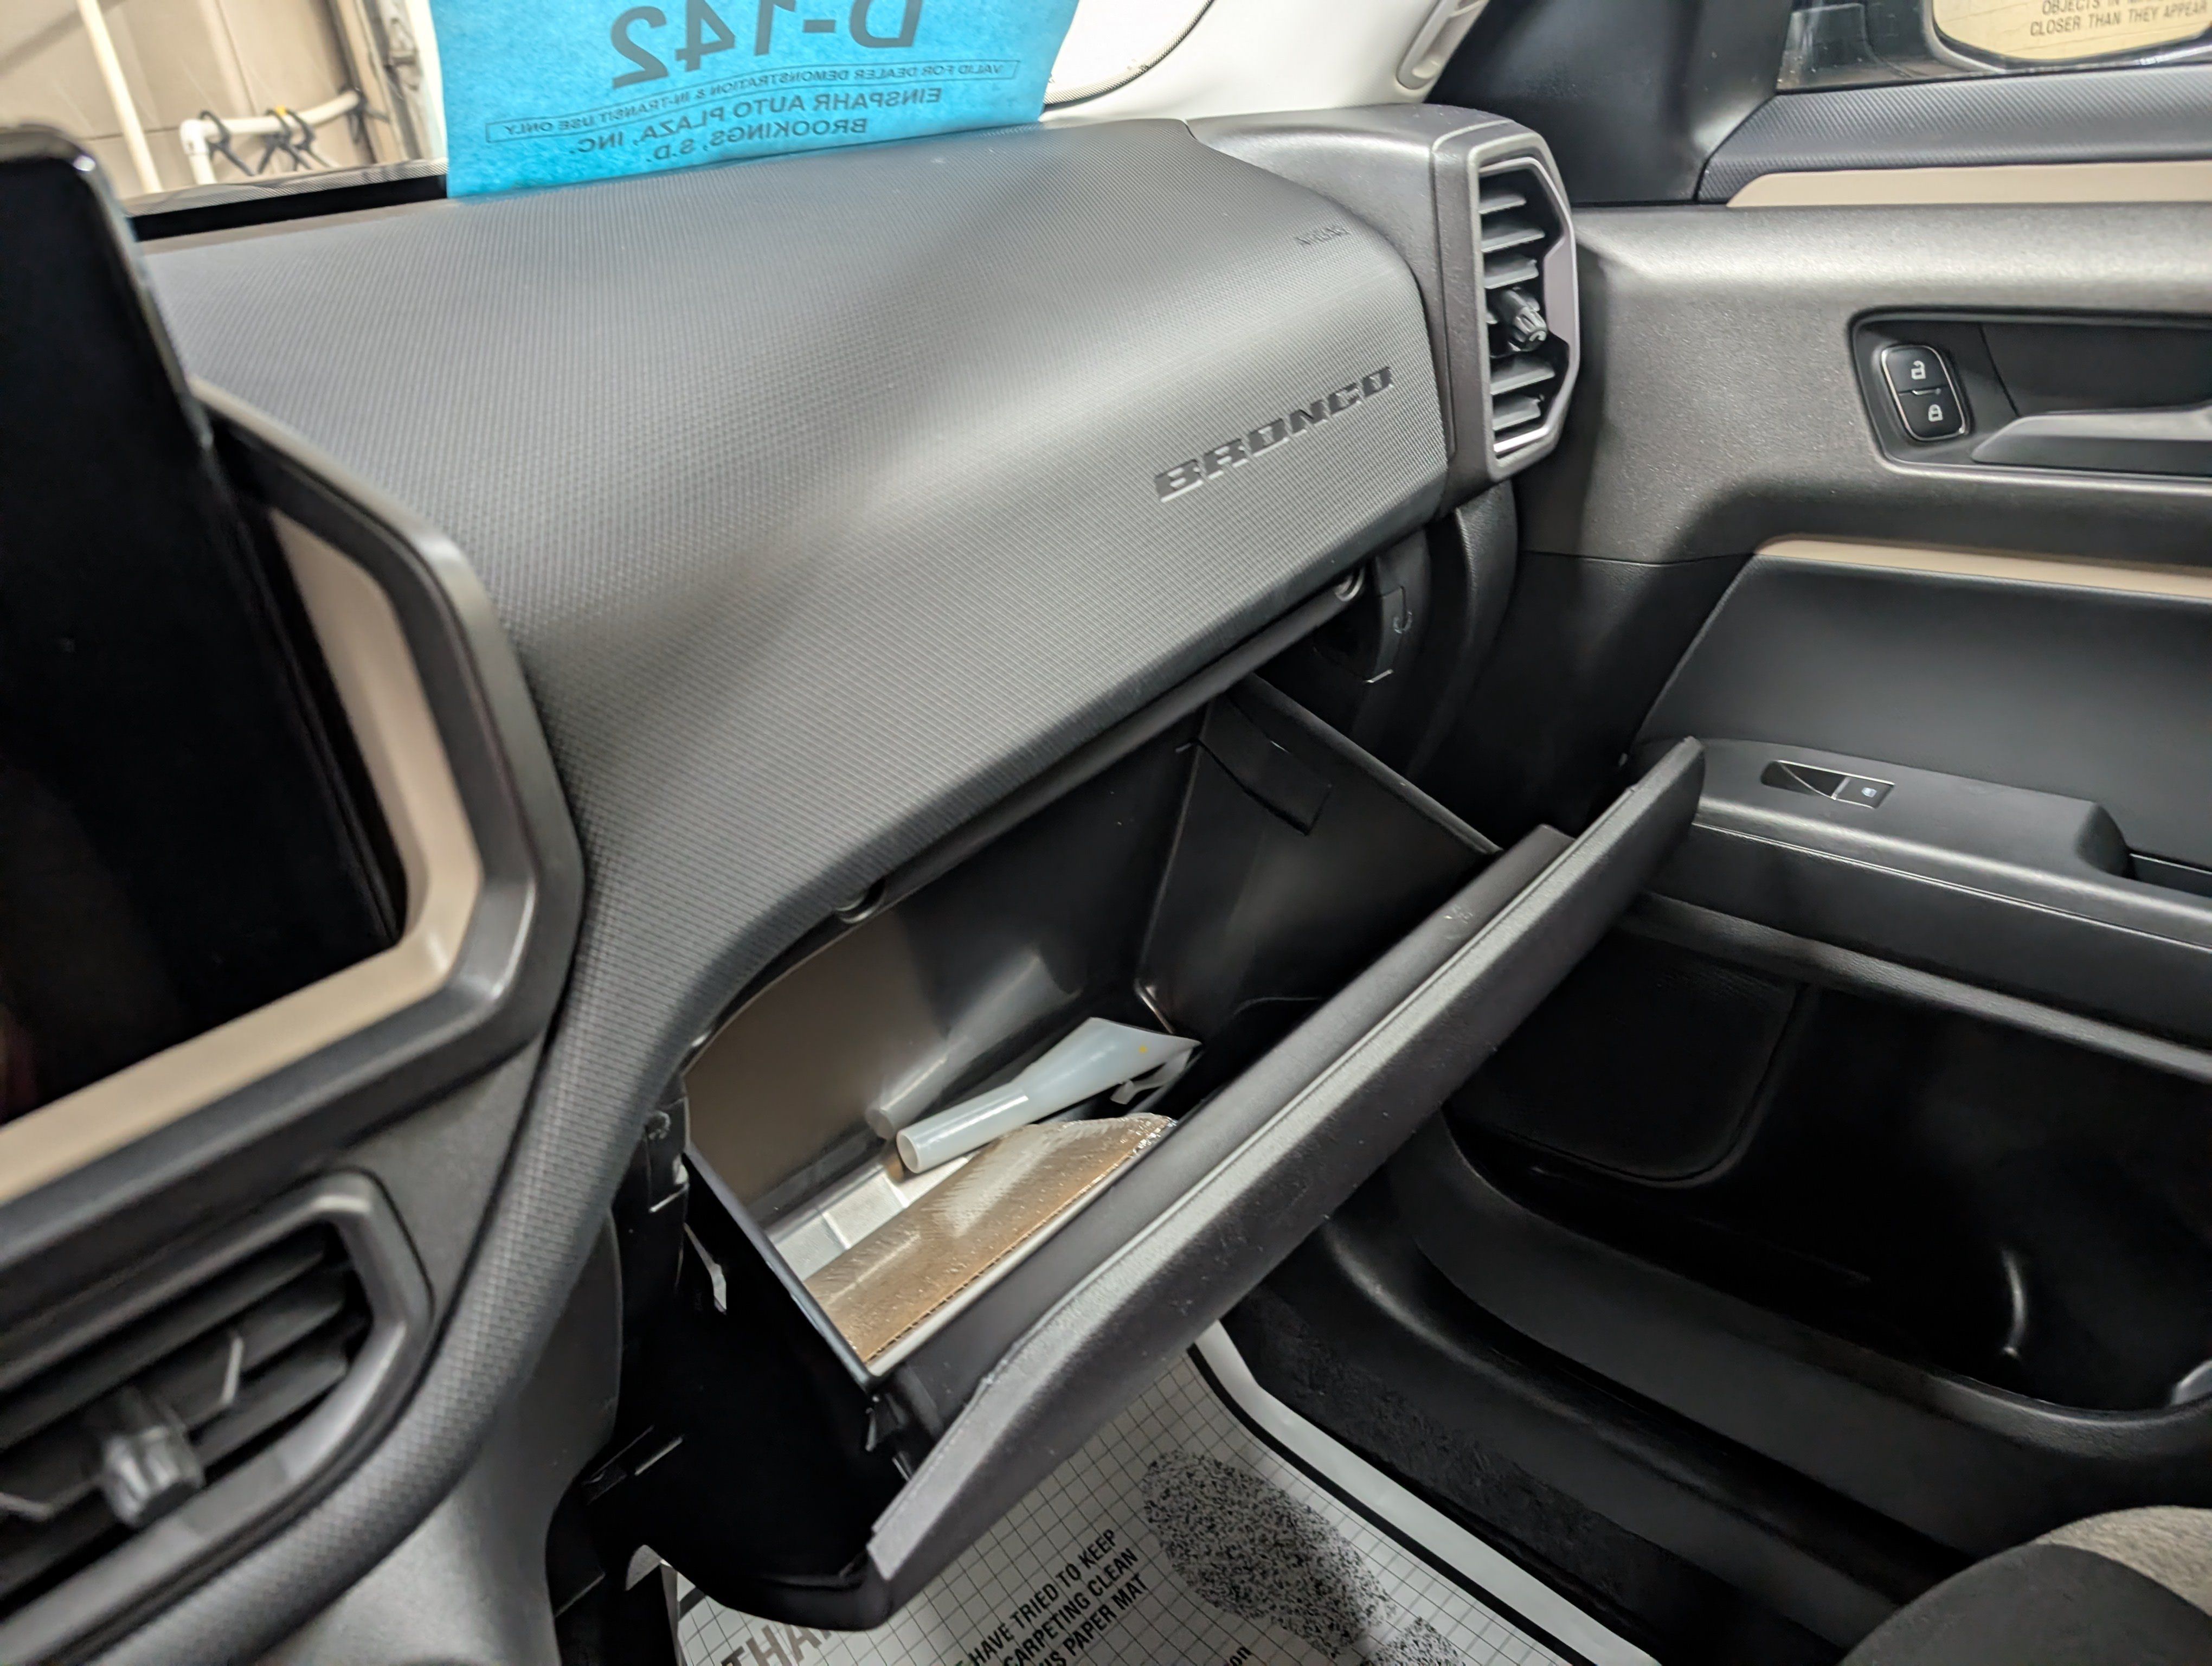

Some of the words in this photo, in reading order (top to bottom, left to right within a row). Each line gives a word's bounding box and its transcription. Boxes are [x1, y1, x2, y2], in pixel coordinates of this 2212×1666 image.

[2030, 15, 2081, 36] CLOSER
[2088, 12, 2121, 28] THAN
[2129, 7, 2158, 22] THEY
[2163, 1, 2208, 17] APPEAR
[1155, 367, 1393, 502] BRONCO
[968, 1623, 1014, 1666] HAVE
[1009, 1583, 1059, 1629] TRIED
[1056, 1563, 1081, 1588] TO
[1078, 1528, 1116, 1569] KEEP
[1004, 1592, 1090, 1666] CARPETING
[1087, 1548, 1139, 1597] CLEAN
[1063, 1604, 1118, 1656] PAPER
[1111, 1573, 1148, 1611] MAT
